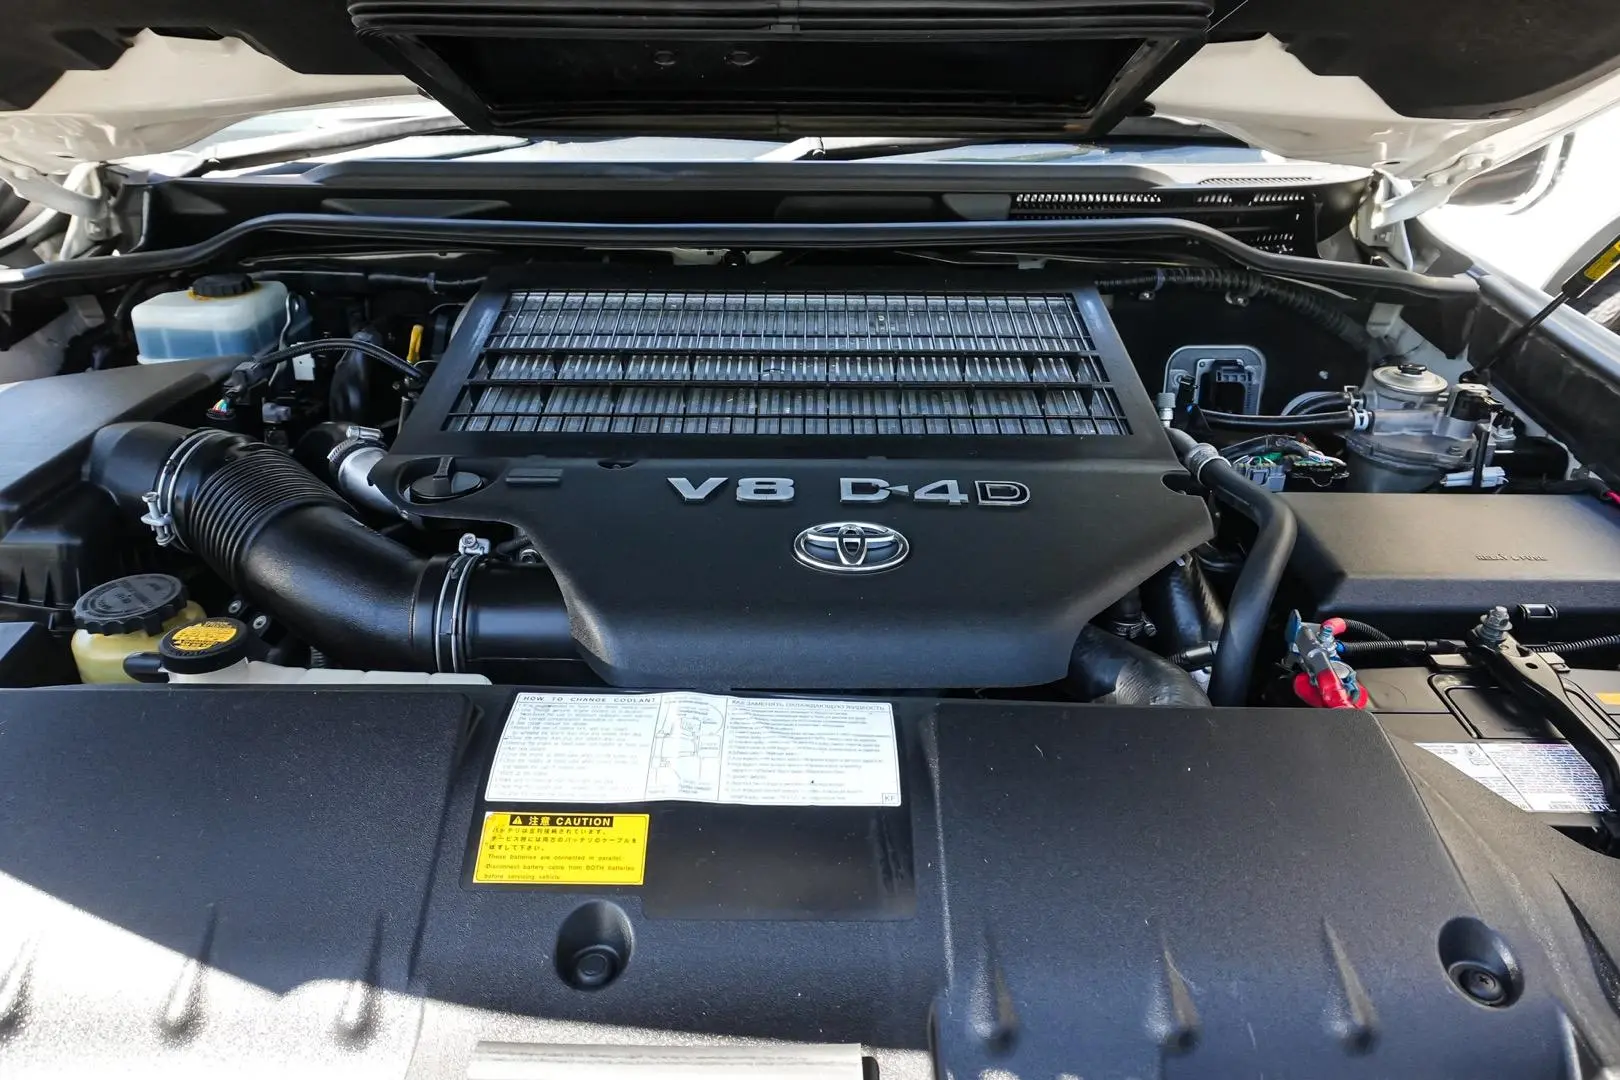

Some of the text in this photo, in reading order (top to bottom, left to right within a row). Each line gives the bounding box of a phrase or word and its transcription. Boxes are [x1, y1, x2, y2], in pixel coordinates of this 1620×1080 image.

[667, 477, 795, 502] V8
[528, 815, 611, 827] 注意 CAUTION
